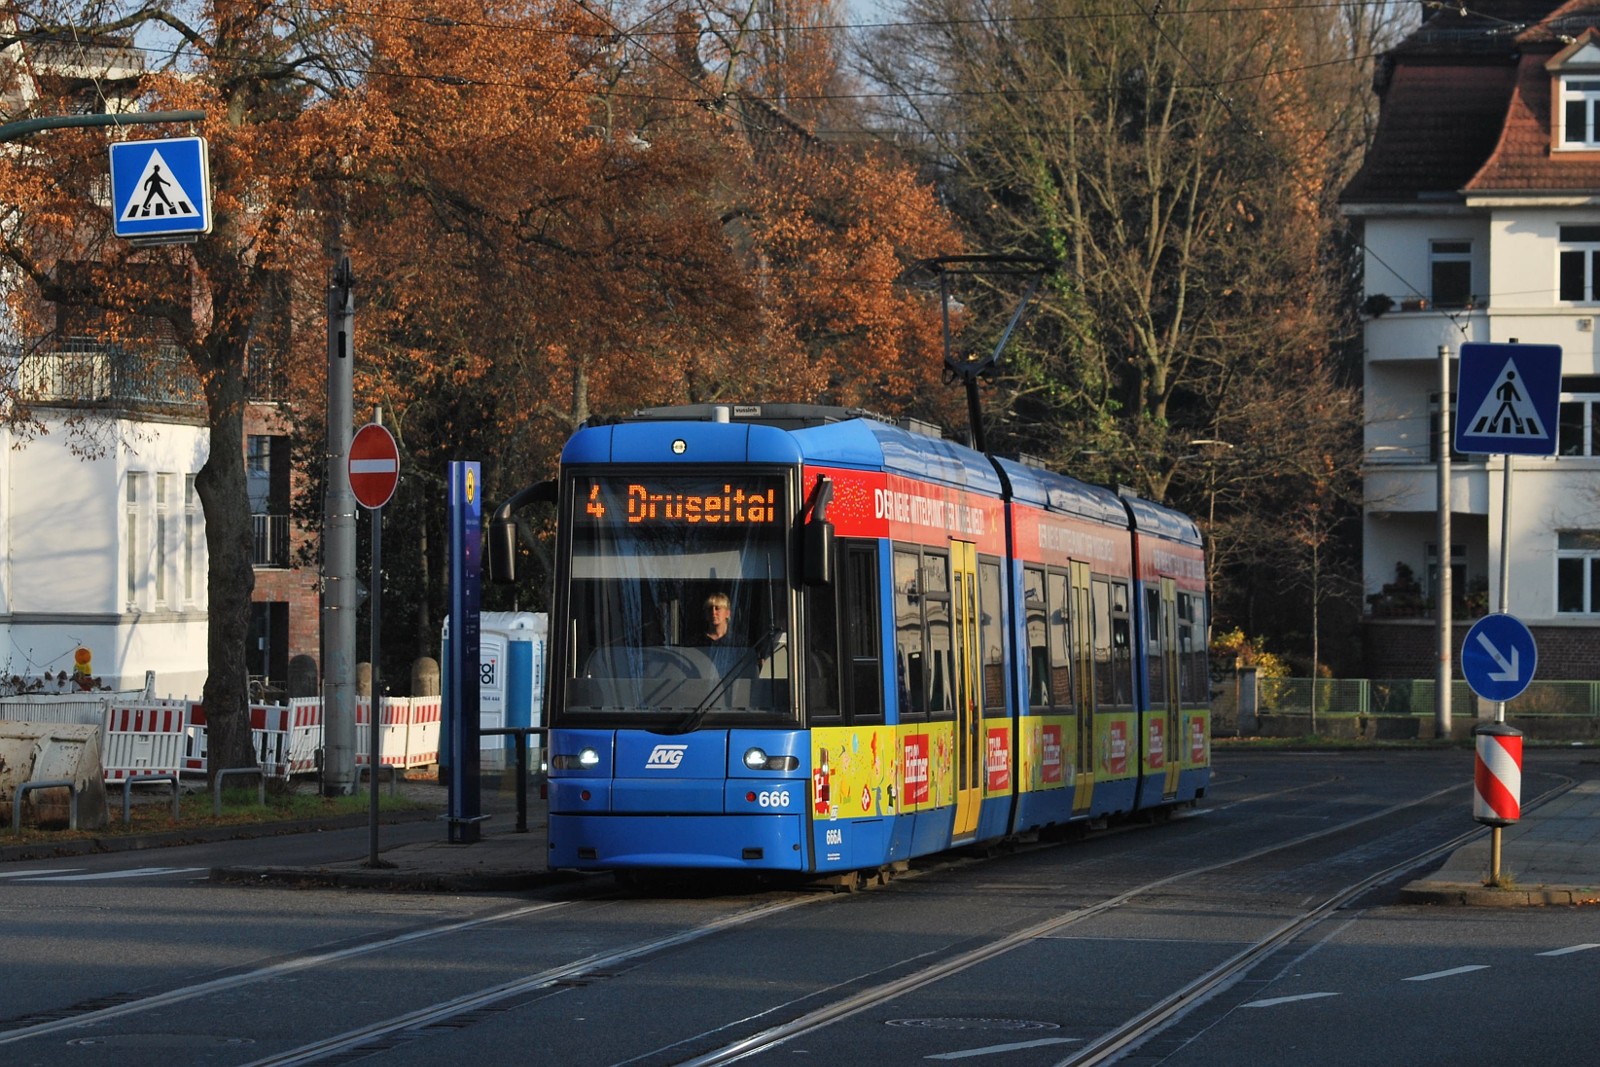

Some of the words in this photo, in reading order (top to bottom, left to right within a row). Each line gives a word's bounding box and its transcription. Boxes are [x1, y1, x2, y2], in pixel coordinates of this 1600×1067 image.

[586, 484, 605, 518] 4
[874, 488, 894, 521] DER
[480, 659, 495, 674] oi
[480, 673, 495, 685] oi
[646, 748, 685, 766] KVG
[759, 791, 790, 807] 666
[826, 828, 842, 845] 666A
